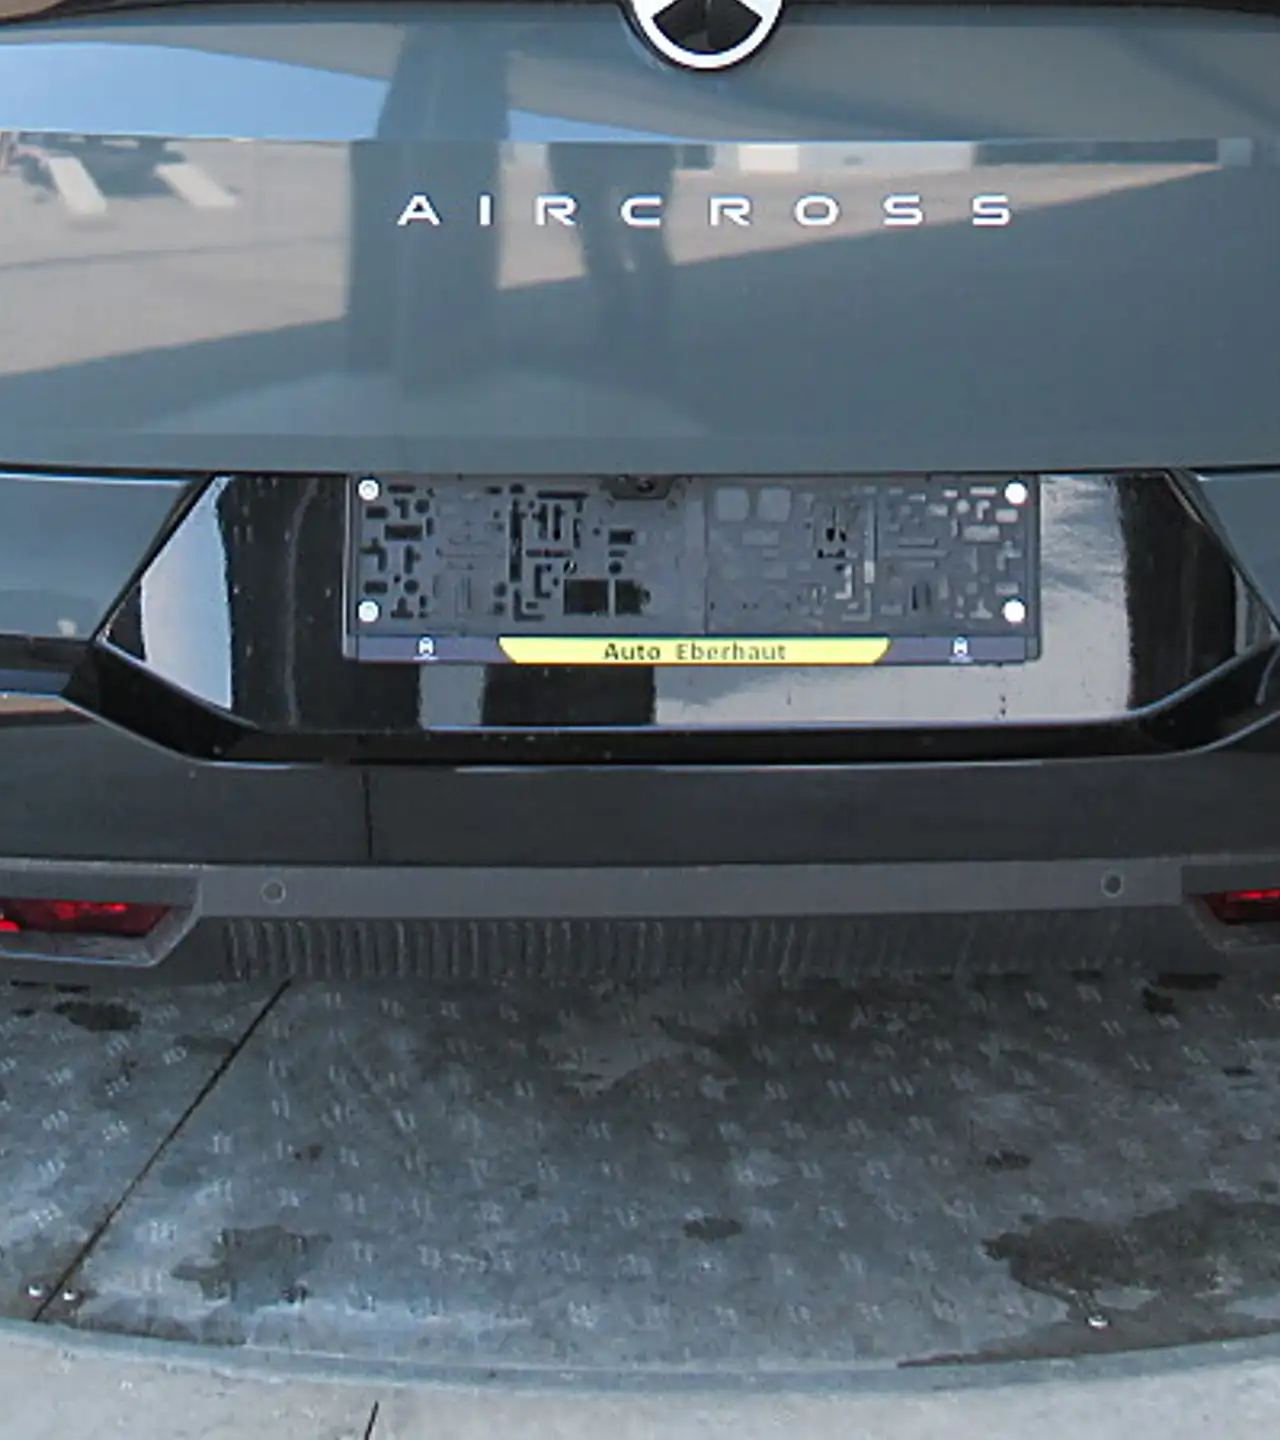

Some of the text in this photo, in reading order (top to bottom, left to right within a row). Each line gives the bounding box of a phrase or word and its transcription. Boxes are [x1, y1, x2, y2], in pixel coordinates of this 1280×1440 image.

[397, 194, 1011, 227] AIRCROSS
[603, 642, 787, 661] Auto Eberhaut
